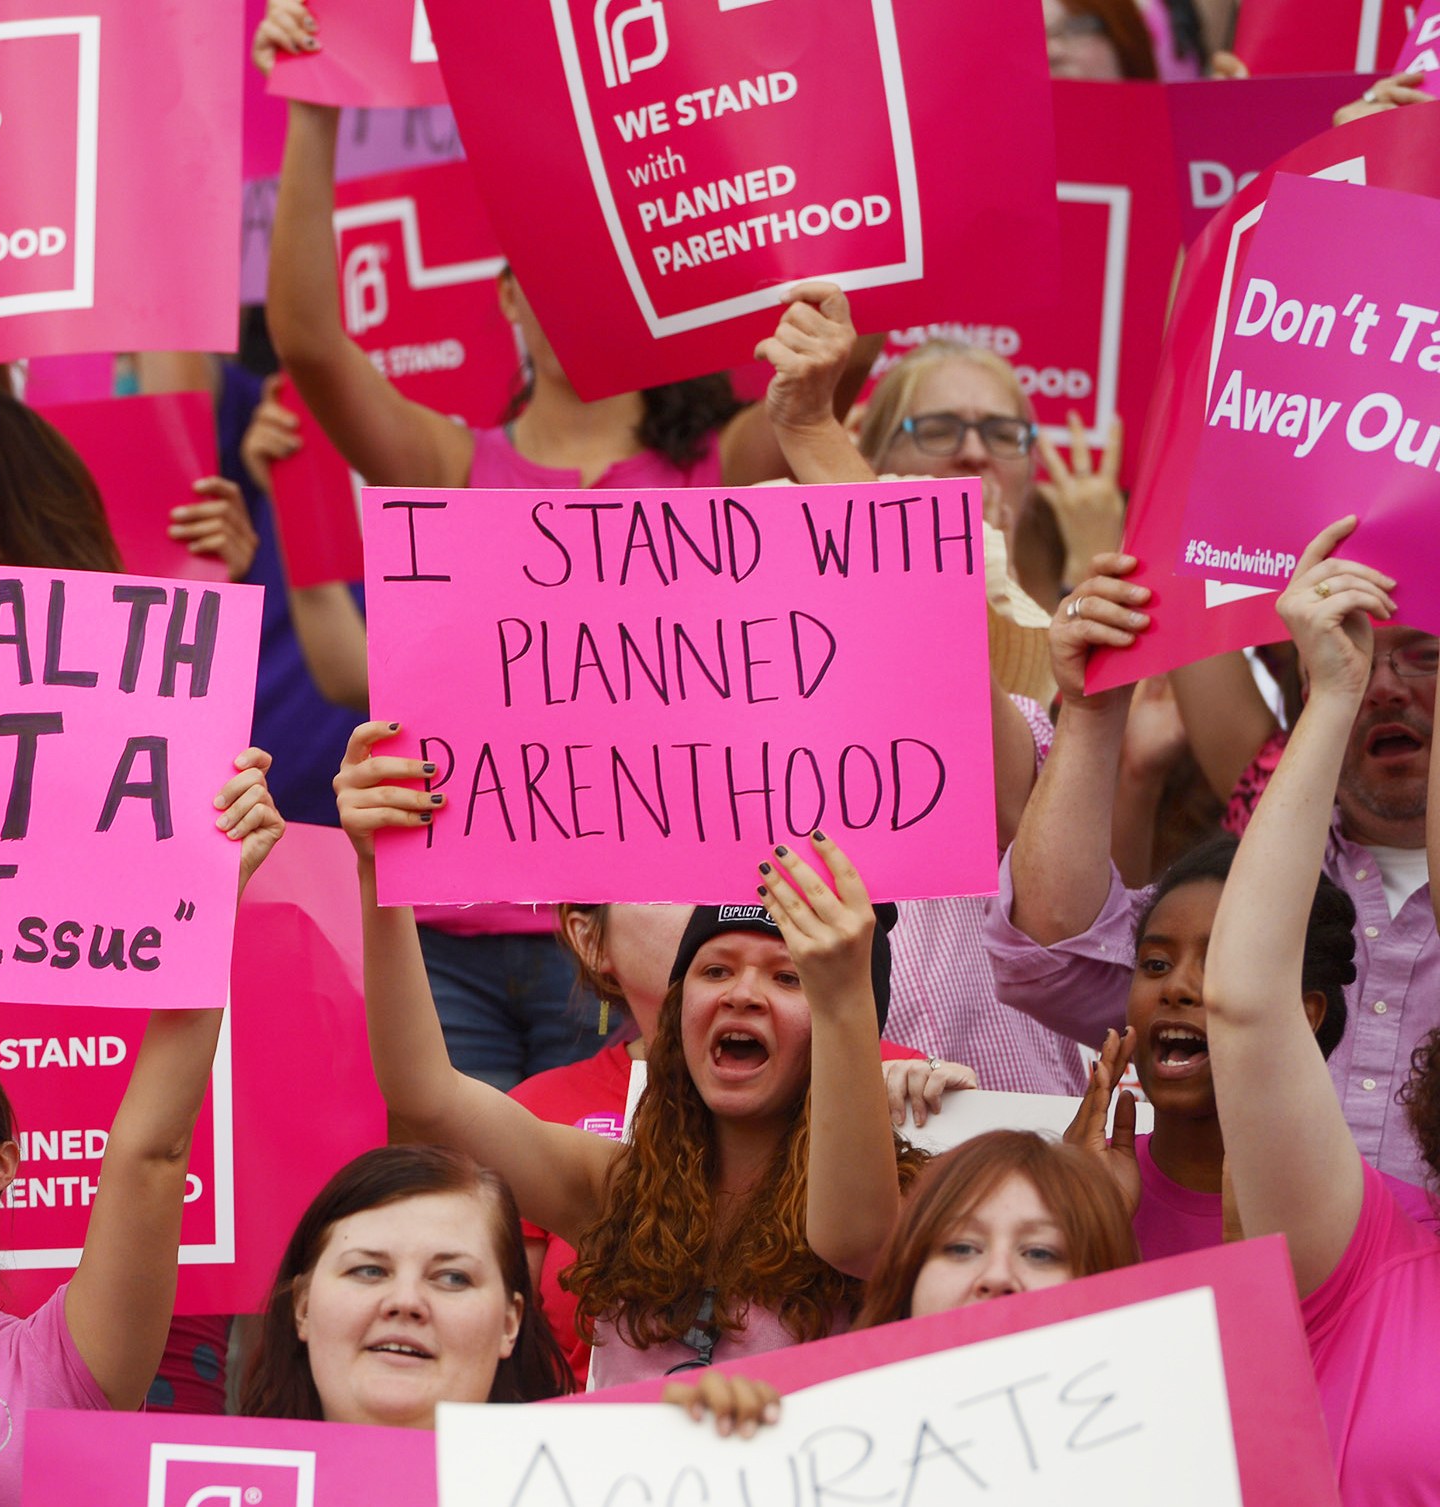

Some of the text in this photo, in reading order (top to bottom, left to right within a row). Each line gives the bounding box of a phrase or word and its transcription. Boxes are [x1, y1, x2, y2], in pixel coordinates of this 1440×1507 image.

[614, 71, 798, 143] WE STAND
[627, 145, 686, 188] with
[638, 165, 796, 233] PLANNED
[652, 195, 891, 276] PARENTHOOD
[1234, 278, 1380, 356] Don't
[390, 339, 465, 376] STAND
[1208, 369, 1440, 473] Away Ou
[382, 491, 974, 587] I STAND WITH
[1184, 539, 1297, 578] #StandwithPP
[497, 609, 837, 707] PLANNED
[95, 735, 173, 841] A
[419, 736, 946, 848] PARENTHOOD
[723, 906, 763, 918] EXPLICIT
